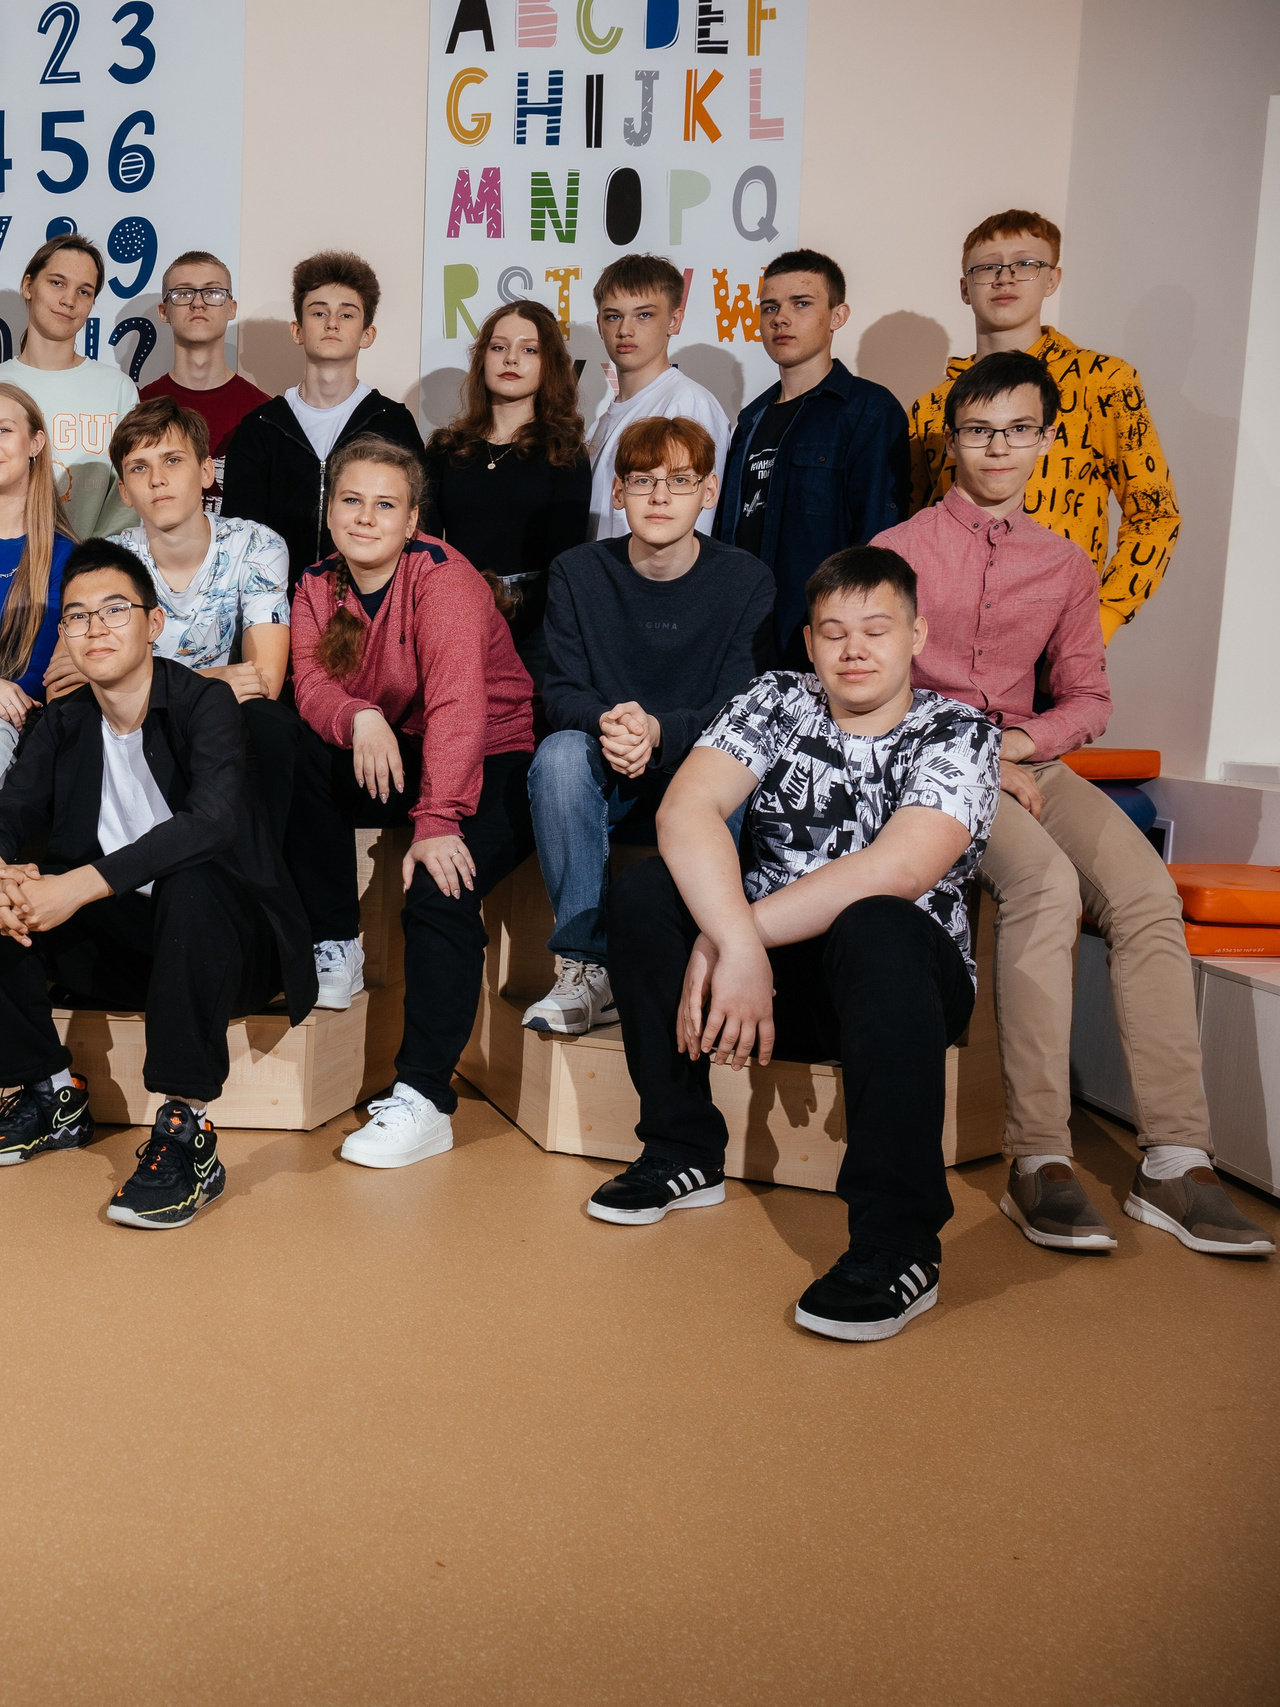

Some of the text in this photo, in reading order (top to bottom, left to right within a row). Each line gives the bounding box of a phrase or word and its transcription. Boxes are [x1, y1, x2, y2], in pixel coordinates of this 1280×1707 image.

[37, 1, 81, 84] 2
[108, 0, 156, 84] 3
[445, 0, 495, 54] A
[446, 67, 491, 147] G
[514, 70, 563, 145] H
[623, 70, 659, 147] J
[683, 69, 724, 143] K
[749, 68, 784, 141] L
[36, 110, 89, 194] 5
[107, 110, 155, 193] 6
[446, 167, 505, 239] M
[531, 169, 580, 243] N
[666, 169, 711, 245] P
[732, 165, 780, 244] Q
[107, 216, 158, 299] 9
[443, 264, 479, 339] R
[924, 755, 965, 780] NIKE
